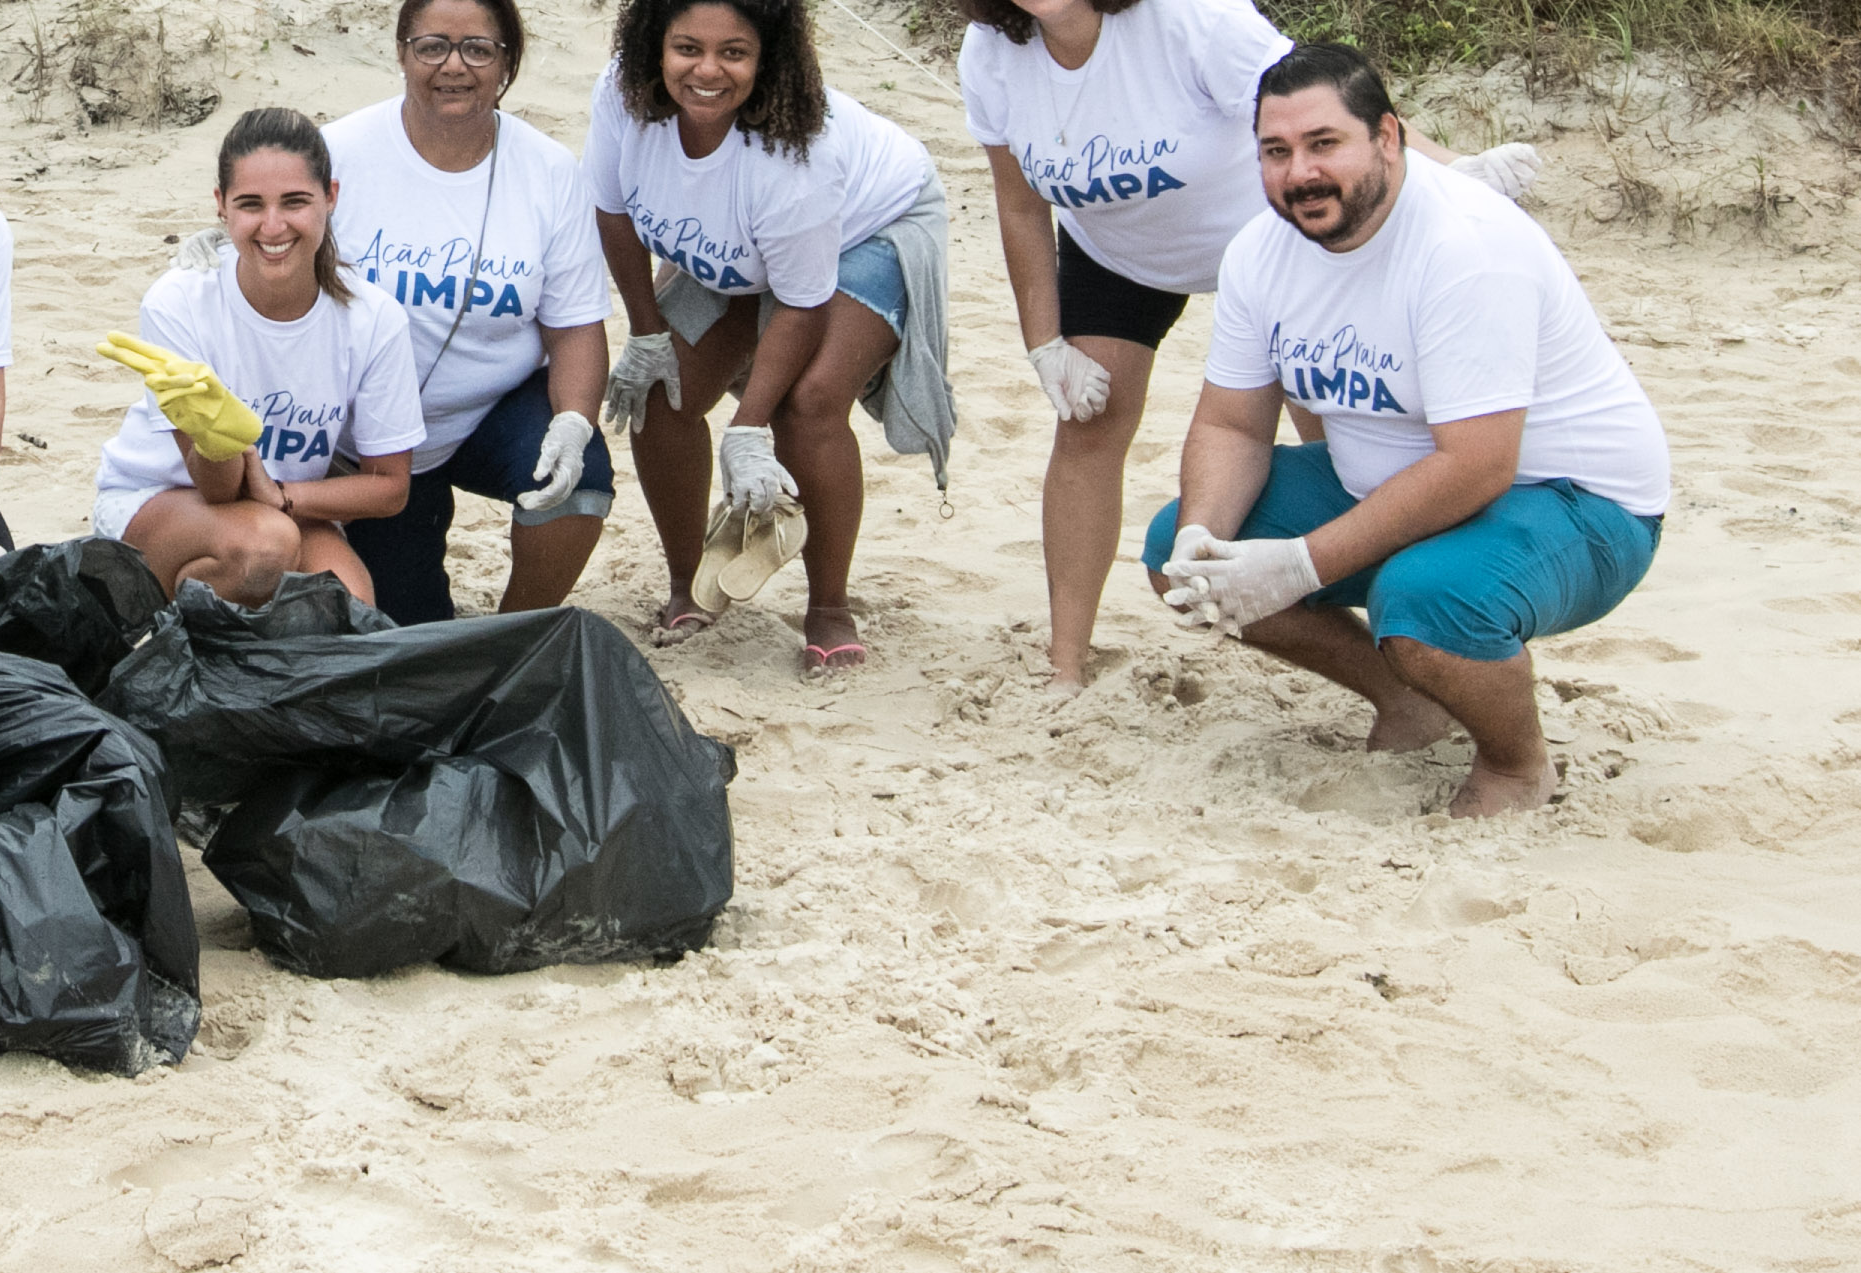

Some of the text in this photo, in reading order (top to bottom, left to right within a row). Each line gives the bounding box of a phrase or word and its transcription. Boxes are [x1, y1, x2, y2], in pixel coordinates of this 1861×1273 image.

[1022, 134, 1179, 183] Ação Praia
[1031, 166, 1187, 209] IMPA
[356, 228, 534, 283] Ação Praia
[642, 232, 756, 290] IMPA
[674, 217, 750, 263] Praia
[1268, 321, 1403, 373] Ação Praia
[263, 391, 344, 427] Praia
[254, 425, 330, 463] MPA
